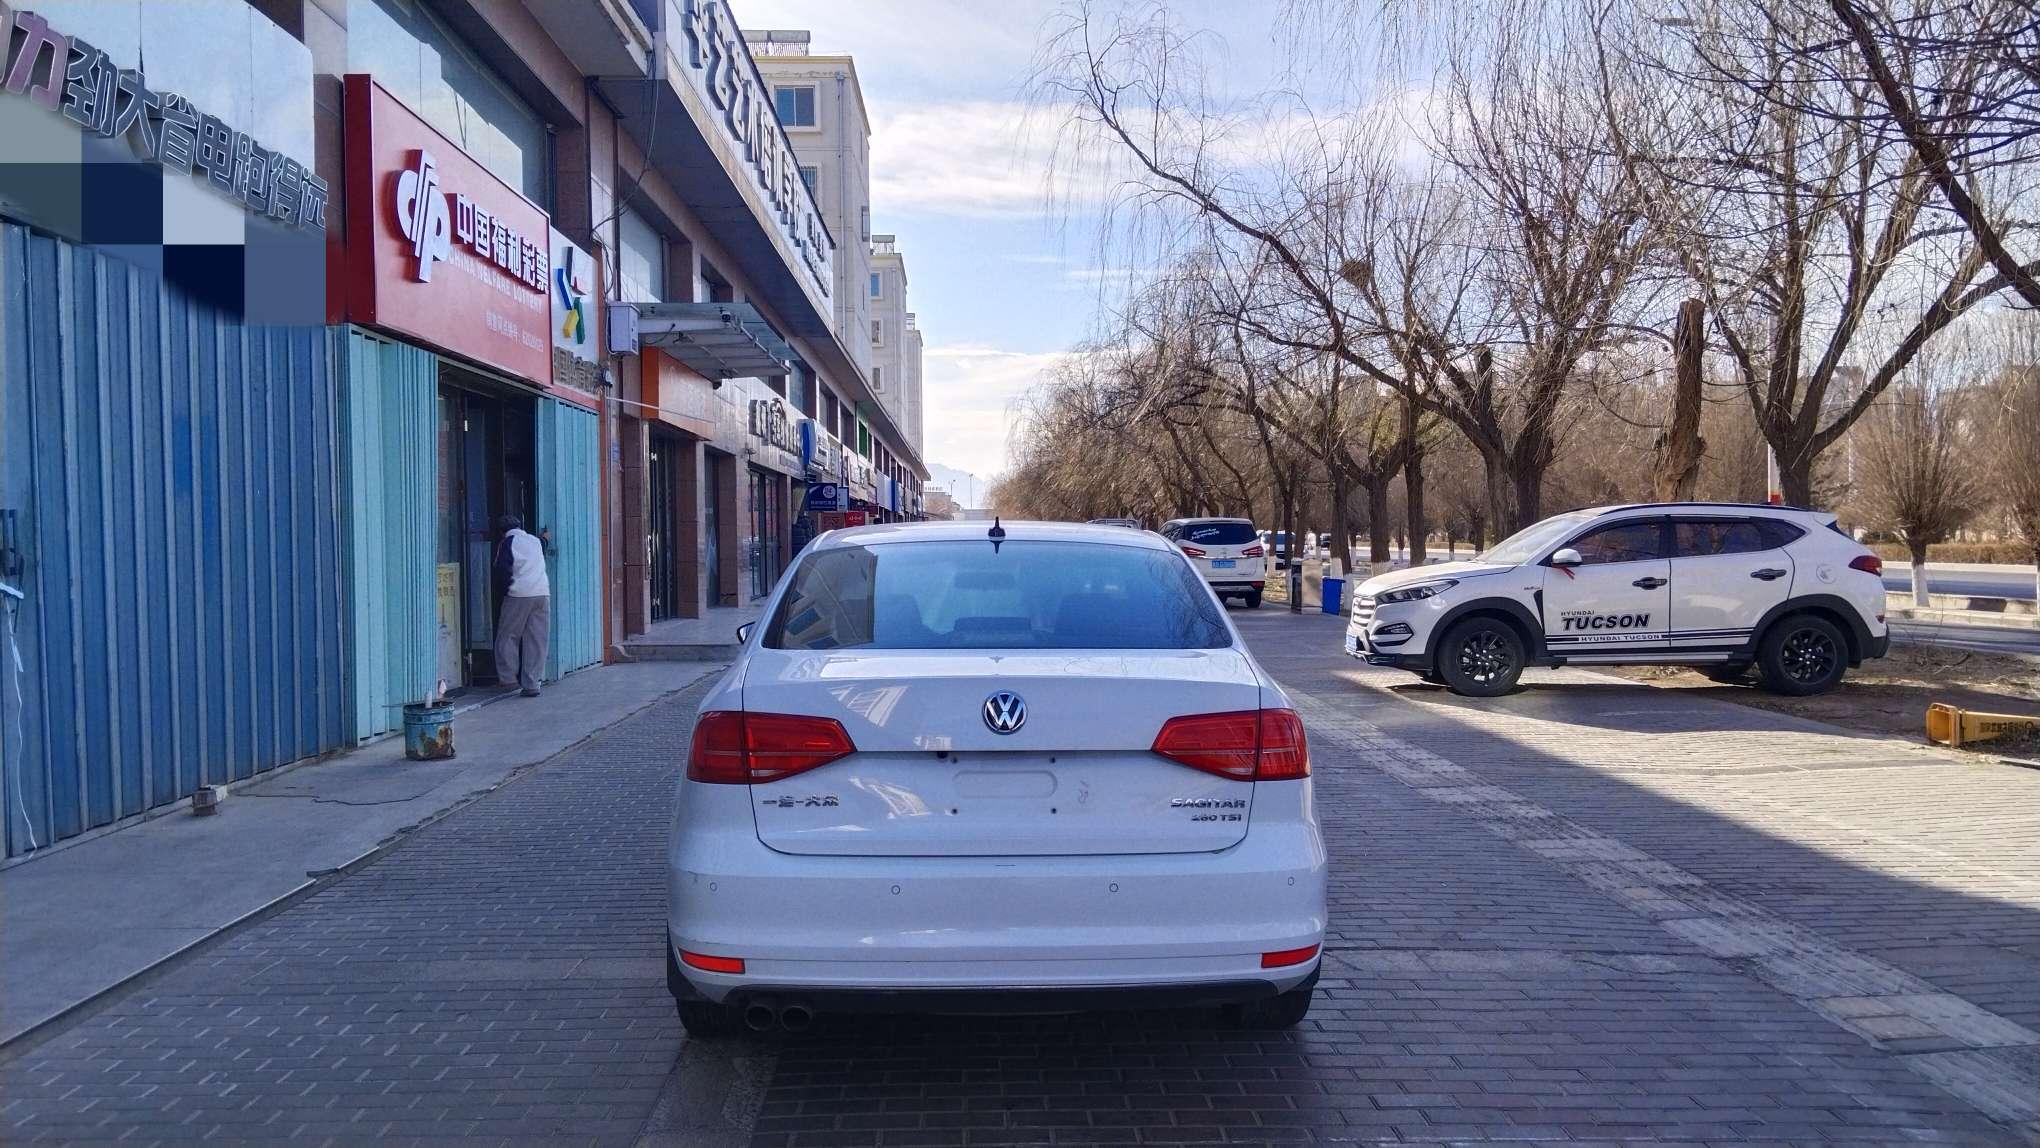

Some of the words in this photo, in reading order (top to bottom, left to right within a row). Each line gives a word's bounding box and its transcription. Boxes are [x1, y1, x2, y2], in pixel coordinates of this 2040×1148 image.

[0, 3, 328, 230] 力劲大省电跑得远
[456, 193, 549, 295] 中国福利彩票
[477, 261, 512, 297] WELFARE
[1561, 613, 1651, 631] TUCSON
[1170, 798, 1246, 808] SAGITAR
[1220, 814, 1242, 822] TSI
